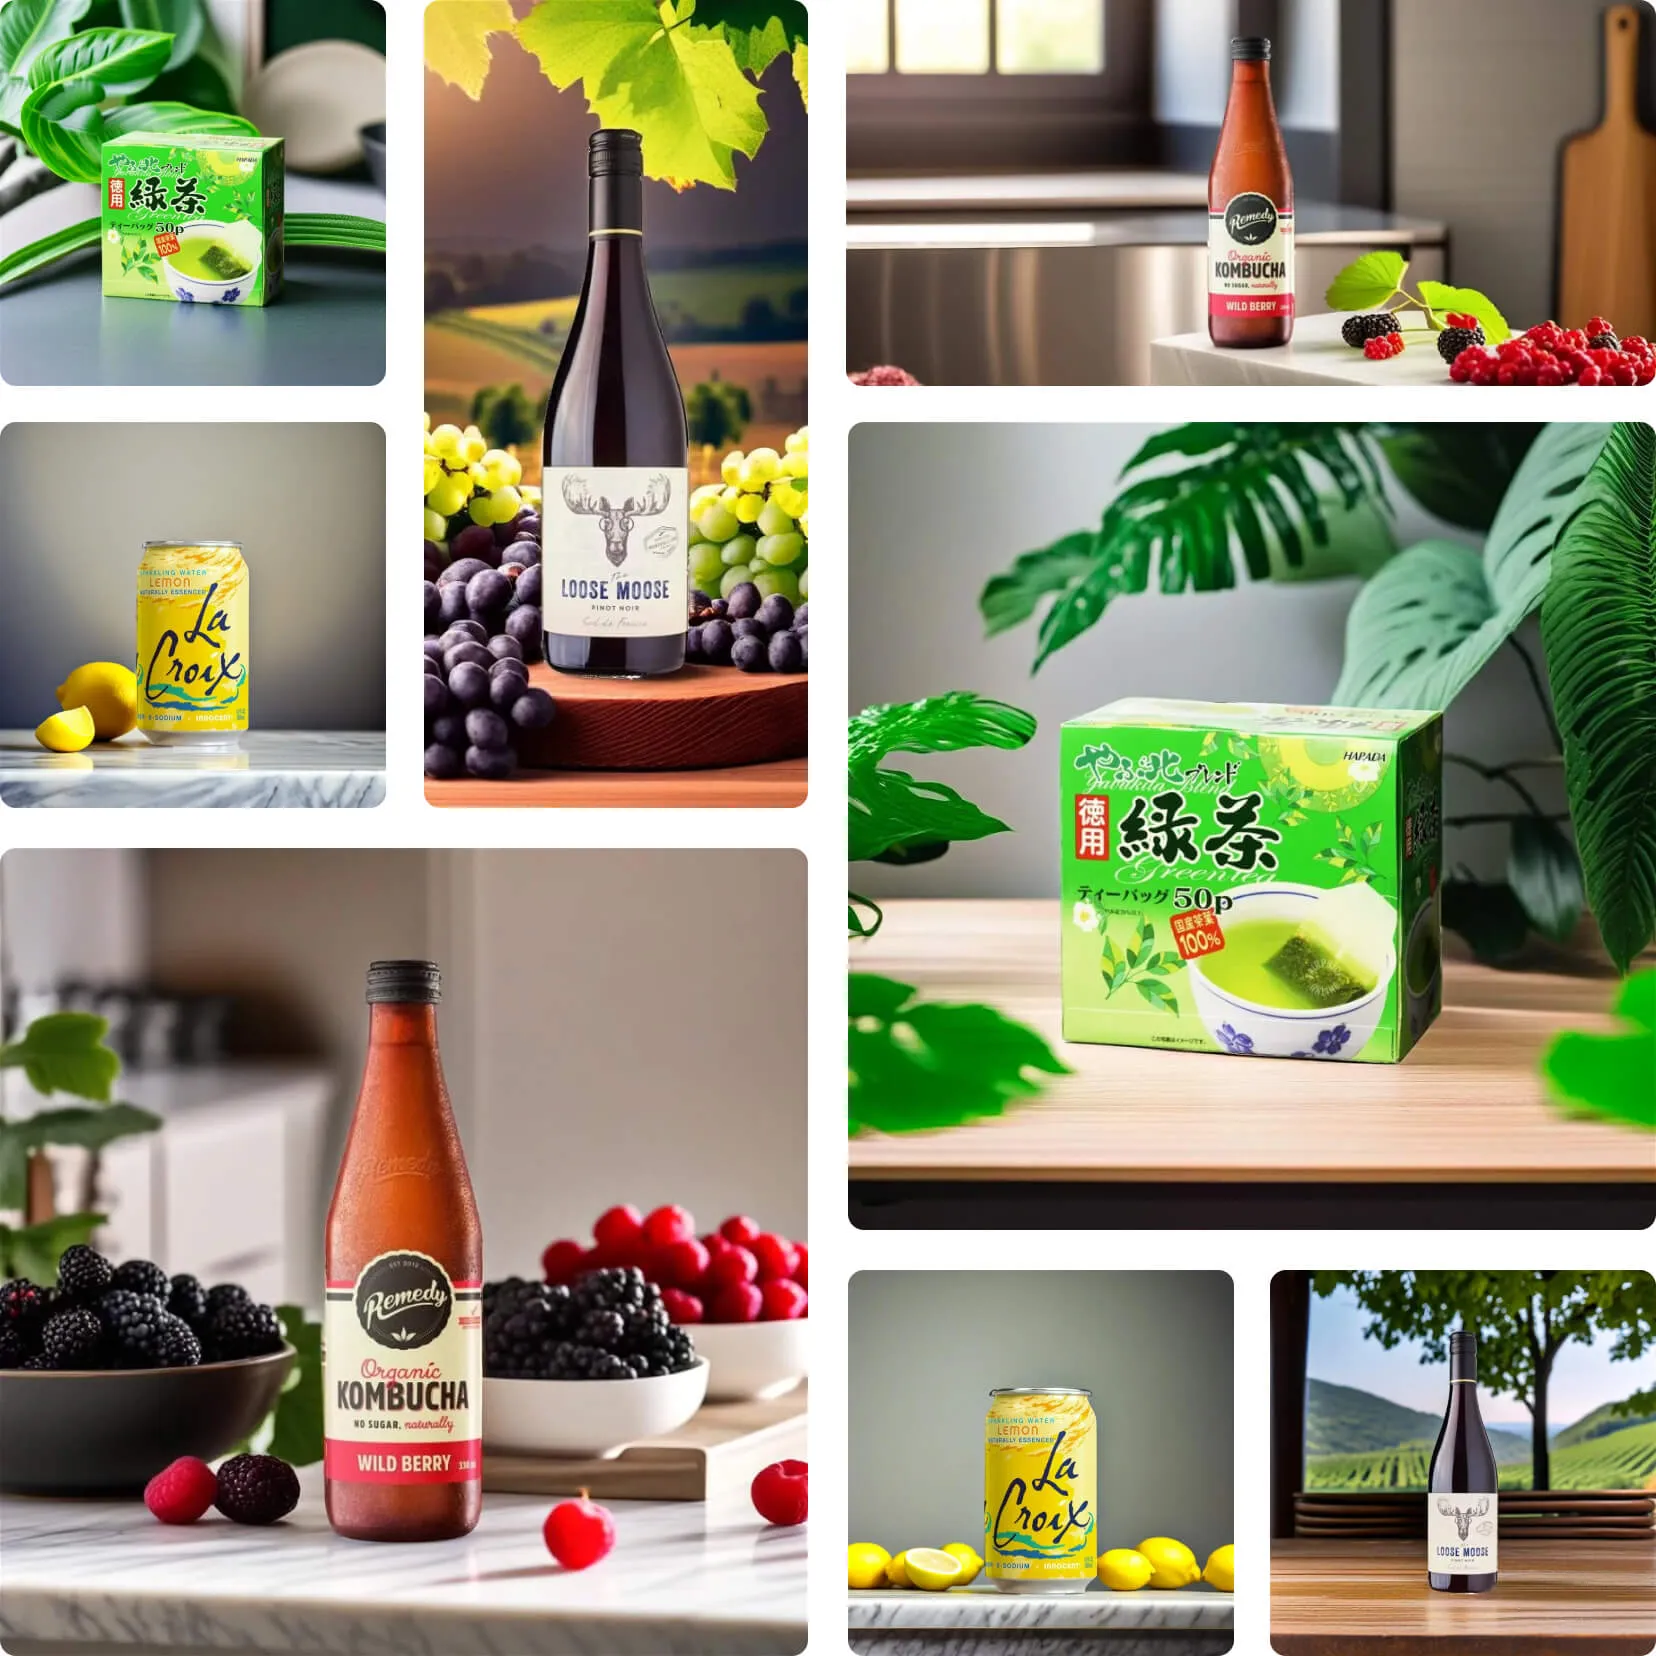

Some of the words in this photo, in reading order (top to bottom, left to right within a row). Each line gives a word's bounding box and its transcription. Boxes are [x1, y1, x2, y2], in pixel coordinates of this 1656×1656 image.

[129, 176, 208, 215] 緑茶
[155, 222, 185, 236] 50p
[1230, 207, 1275, 234] Remedy
[1214, 262, 1287, 279] KOMBUCHA
[1228, 250, 1271, 264] Organic
[1226, 301, 1248, 312] WILD
[1250, 301, 1277, 312] BERRY
[149, 576, 191, 588] LEMON
[561, 578, 609, 600] LOOSE
[616, 579, 670, 600] MOOSE
[184, 582, 231, 649] La
[145, 630, 242, 701] Croix
[1078, 797, 1105, 856] 徳用
[1119, 791, 1280, 872] 緑茶
[1076, 885, 1169, 904] ティーバッグ
[1173, 887, 1233, 915] 50p
[1179, 929, 1221, 956] 100%
[363, 1279, 448, 1330] Remedy
[361, 1358, 441, 1388] Organic
[338, 1380, 469, 1411] KOMBUCHA
[354, 1420, 366, 1429] NO
[405, 1415, 454, 1433] naturally
[997, 1424, 1039, 1436] LEMON
[357, 1454, 398, 1472] WILD
[402, 1454, 451, 1472] BERRY
[1032, 1430, 1079, 1497] La
[993, 1477, 1091, 1549] Croix
[1437, 1546, 1460, 1557] LOOSE
[1463, 1546, 1489, 1557] MOOSE
